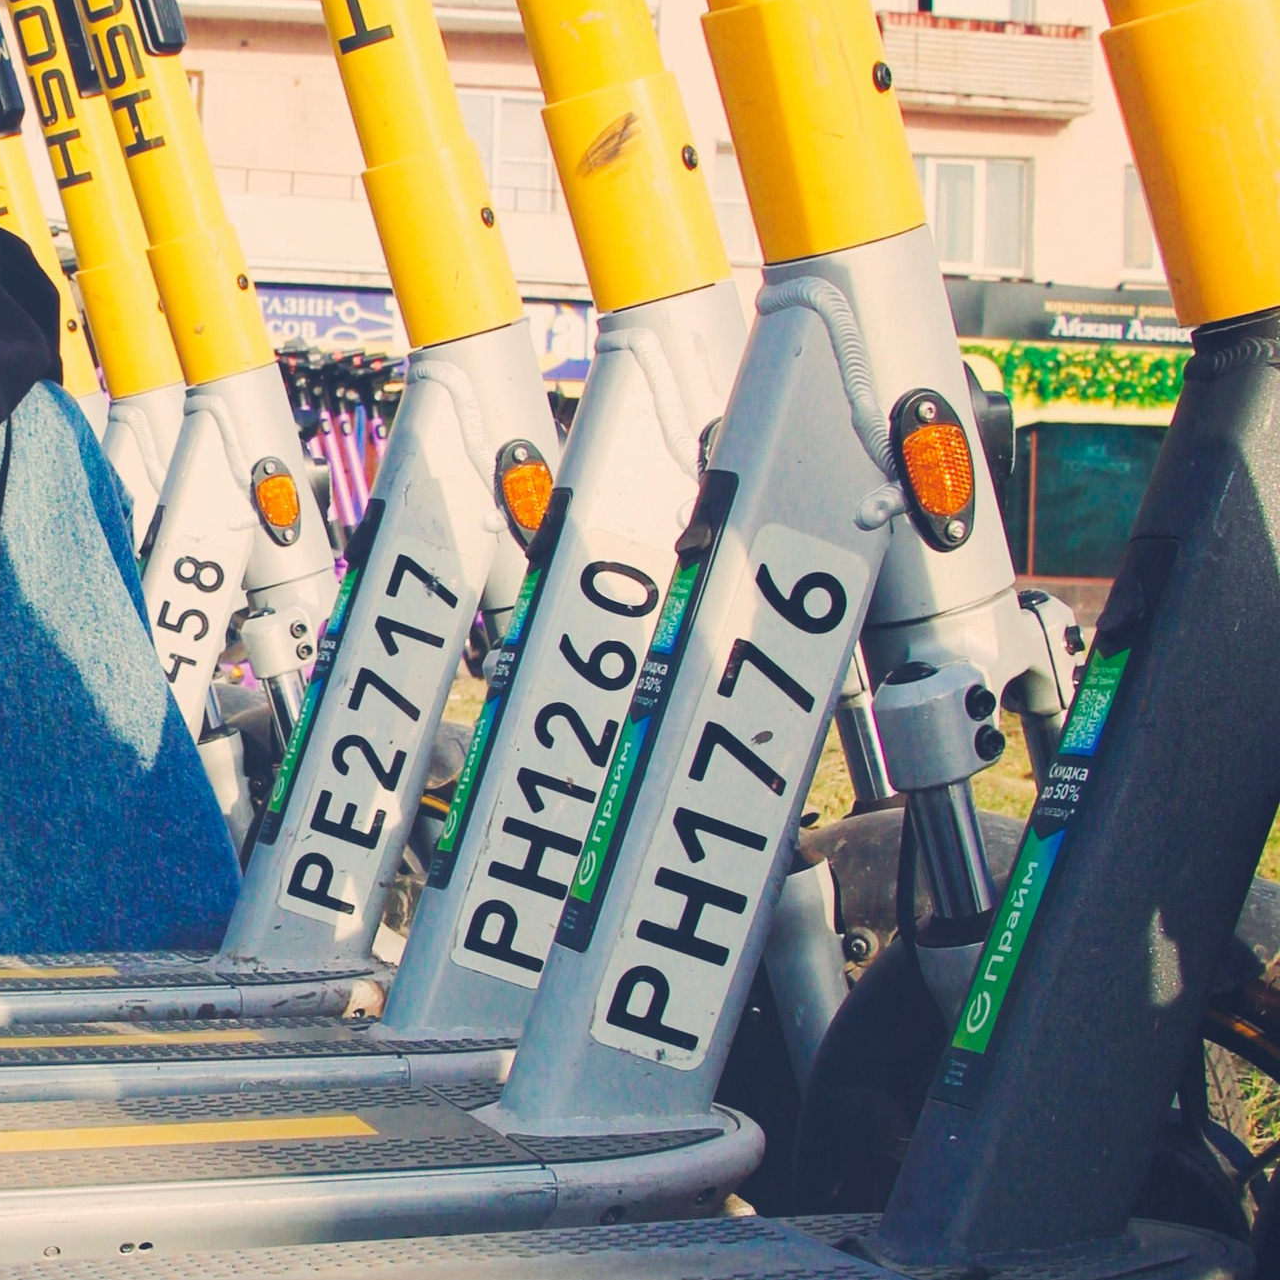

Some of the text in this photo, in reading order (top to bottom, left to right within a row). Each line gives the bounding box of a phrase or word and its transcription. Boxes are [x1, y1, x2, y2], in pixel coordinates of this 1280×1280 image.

[1050, 315, 1124, 340] Айжан
[454, 719, 487, 804] Прайм
[1048, 763, 1089, 782] Скидка
[591, 741, 632, 843] Прайм
[1041, 783, 1081, 802] до 50%
[983, 861, 1039, 982] Прайм
